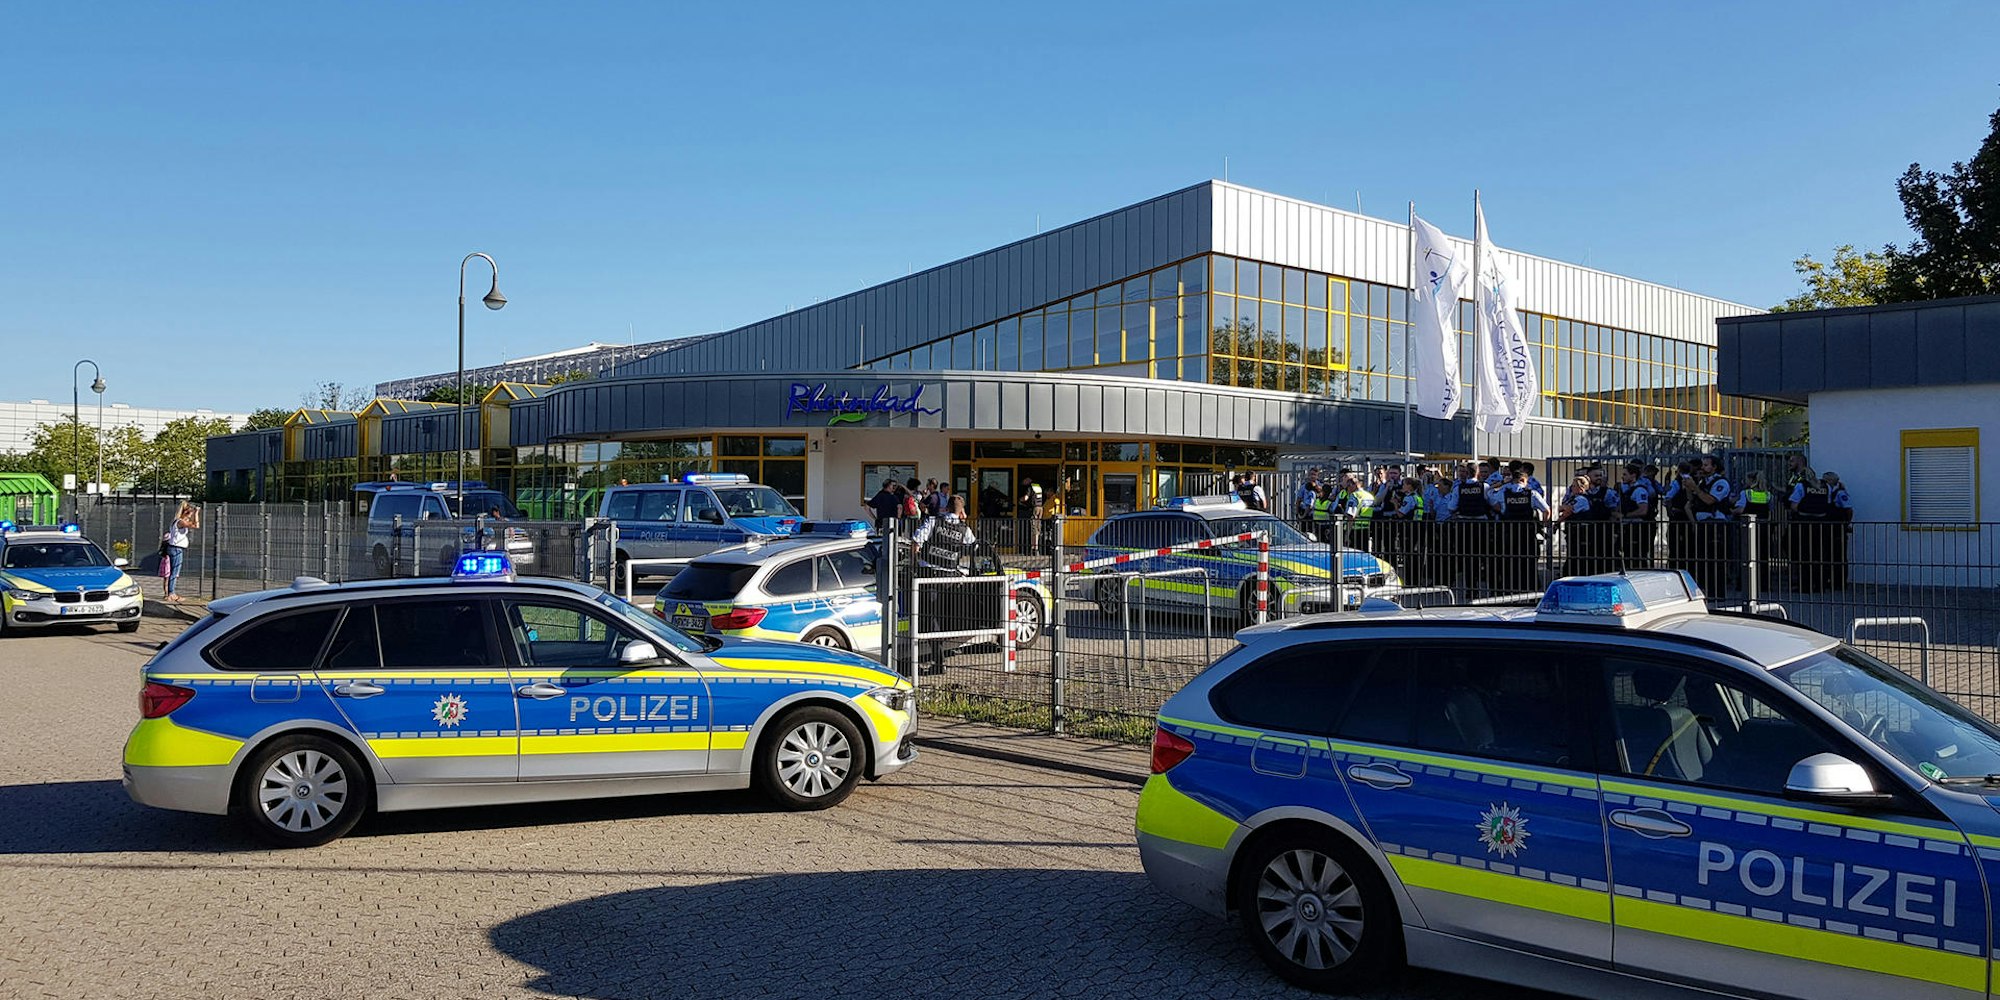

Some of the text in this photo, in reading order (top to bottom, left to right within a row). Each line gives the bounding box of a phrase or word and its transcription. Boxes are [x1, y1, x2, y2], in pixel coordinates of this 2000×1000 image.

[785, 383, 943, 420] Rheinbad
[813, 440, 819, 450] 1
[640, 530, 668, 541] POLIZEI
[936, 526, 963, 540] POLIZEI
[569, 695, 698, 722] POLIZEI
[1699, 841, 1956, 928] POLIZEI
